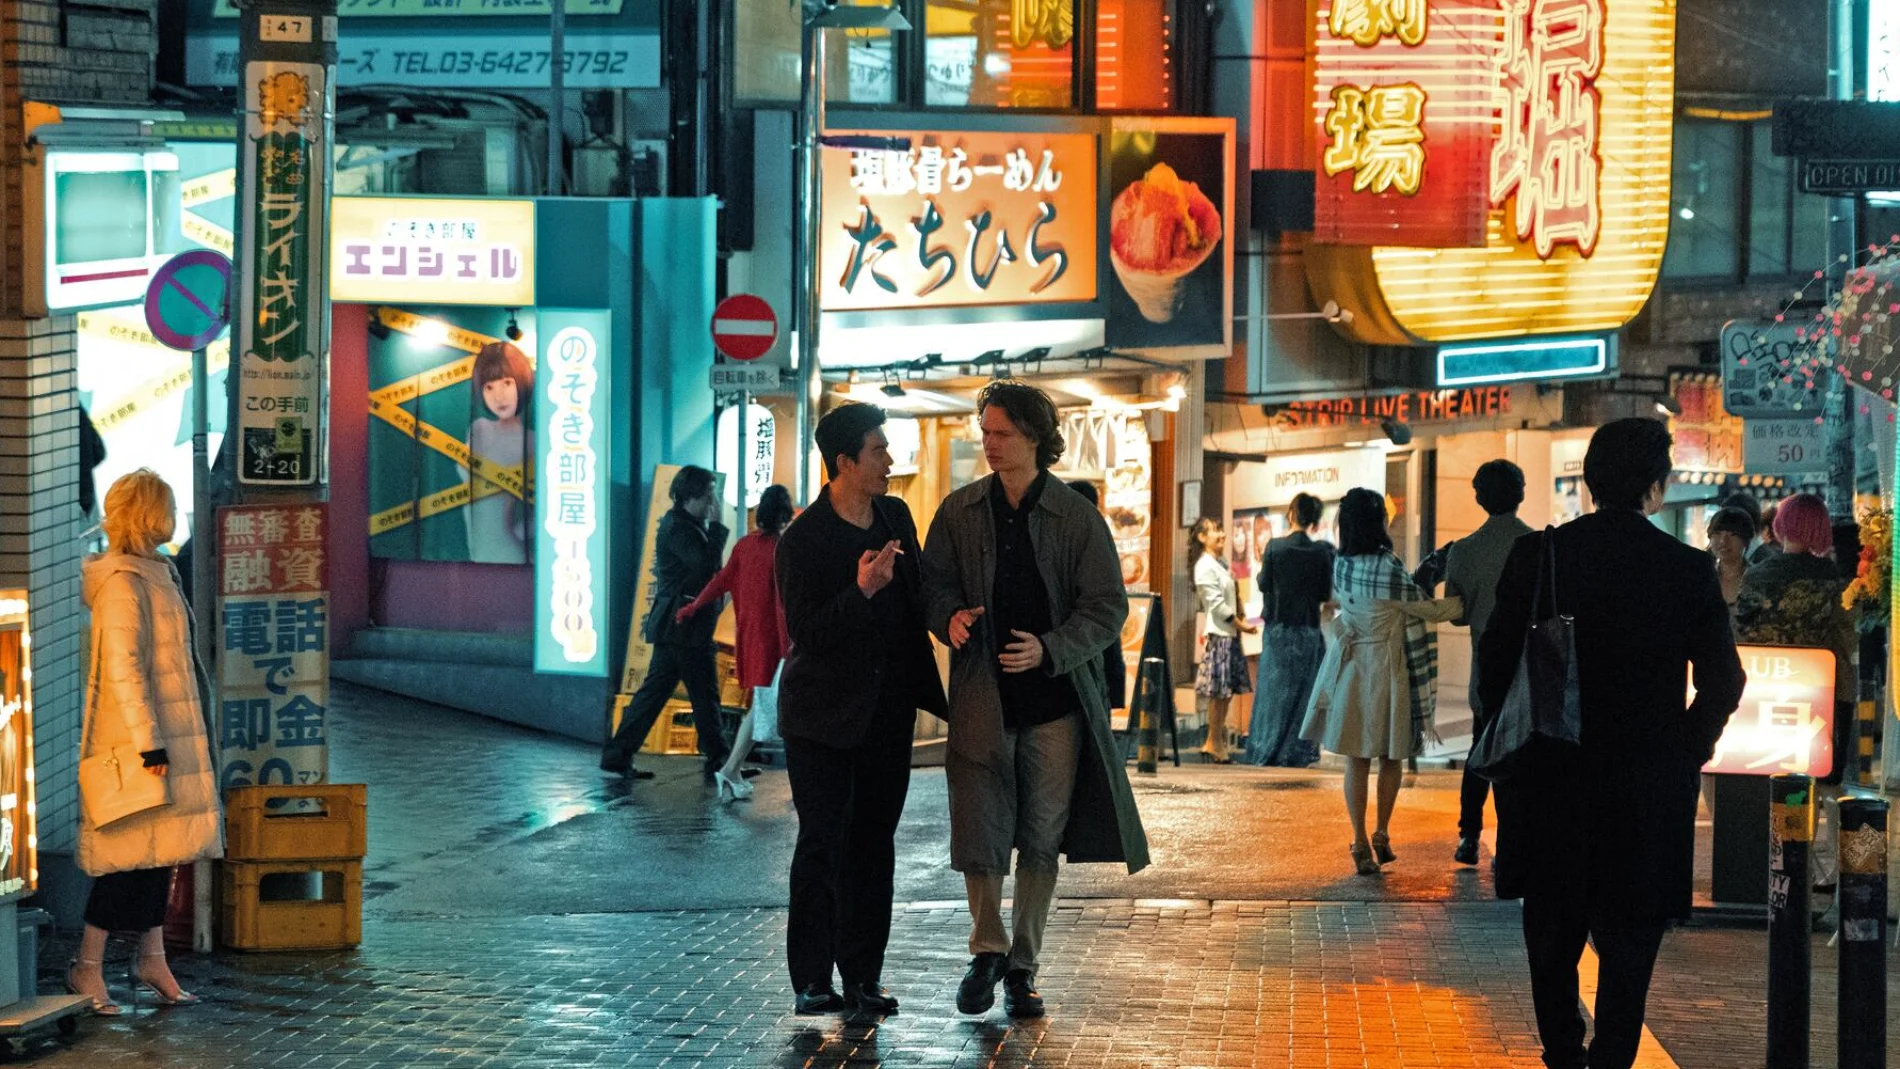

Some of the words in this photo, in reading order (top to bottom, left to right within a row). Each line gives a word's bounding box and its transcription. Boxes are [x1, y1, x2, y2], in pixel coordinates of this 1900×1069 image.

[277, 21, 302, 34] 47
[1811, 165, 1868, 186] OPEN
[839, 199, 1068, 297] たちひら
[257, 192, 305, 346] ライオン
[714, 370, 776, 384] 自転車を除く
[246, 396, 309, 413] この手前
[1287, 398, 1354, 429] STRIP
[1360, 394, 1411, 427] LIVE
[1417, 386, 1513, 422] THEATER
[1752, 424, 1819, 440] 価格改定
[254, 459, 301, 475] 2-20
[1778, 443, 1804, 463] 50
[1275, 467, 1340, 488] INFORMATION
[224, 508, 323, 546] 無審査
[222, 547, 326, 594] 融資
[222, 598, 326, 655] 電話
[253, 656, 295, 696] で
[221, 694, 327, 751] 即金
